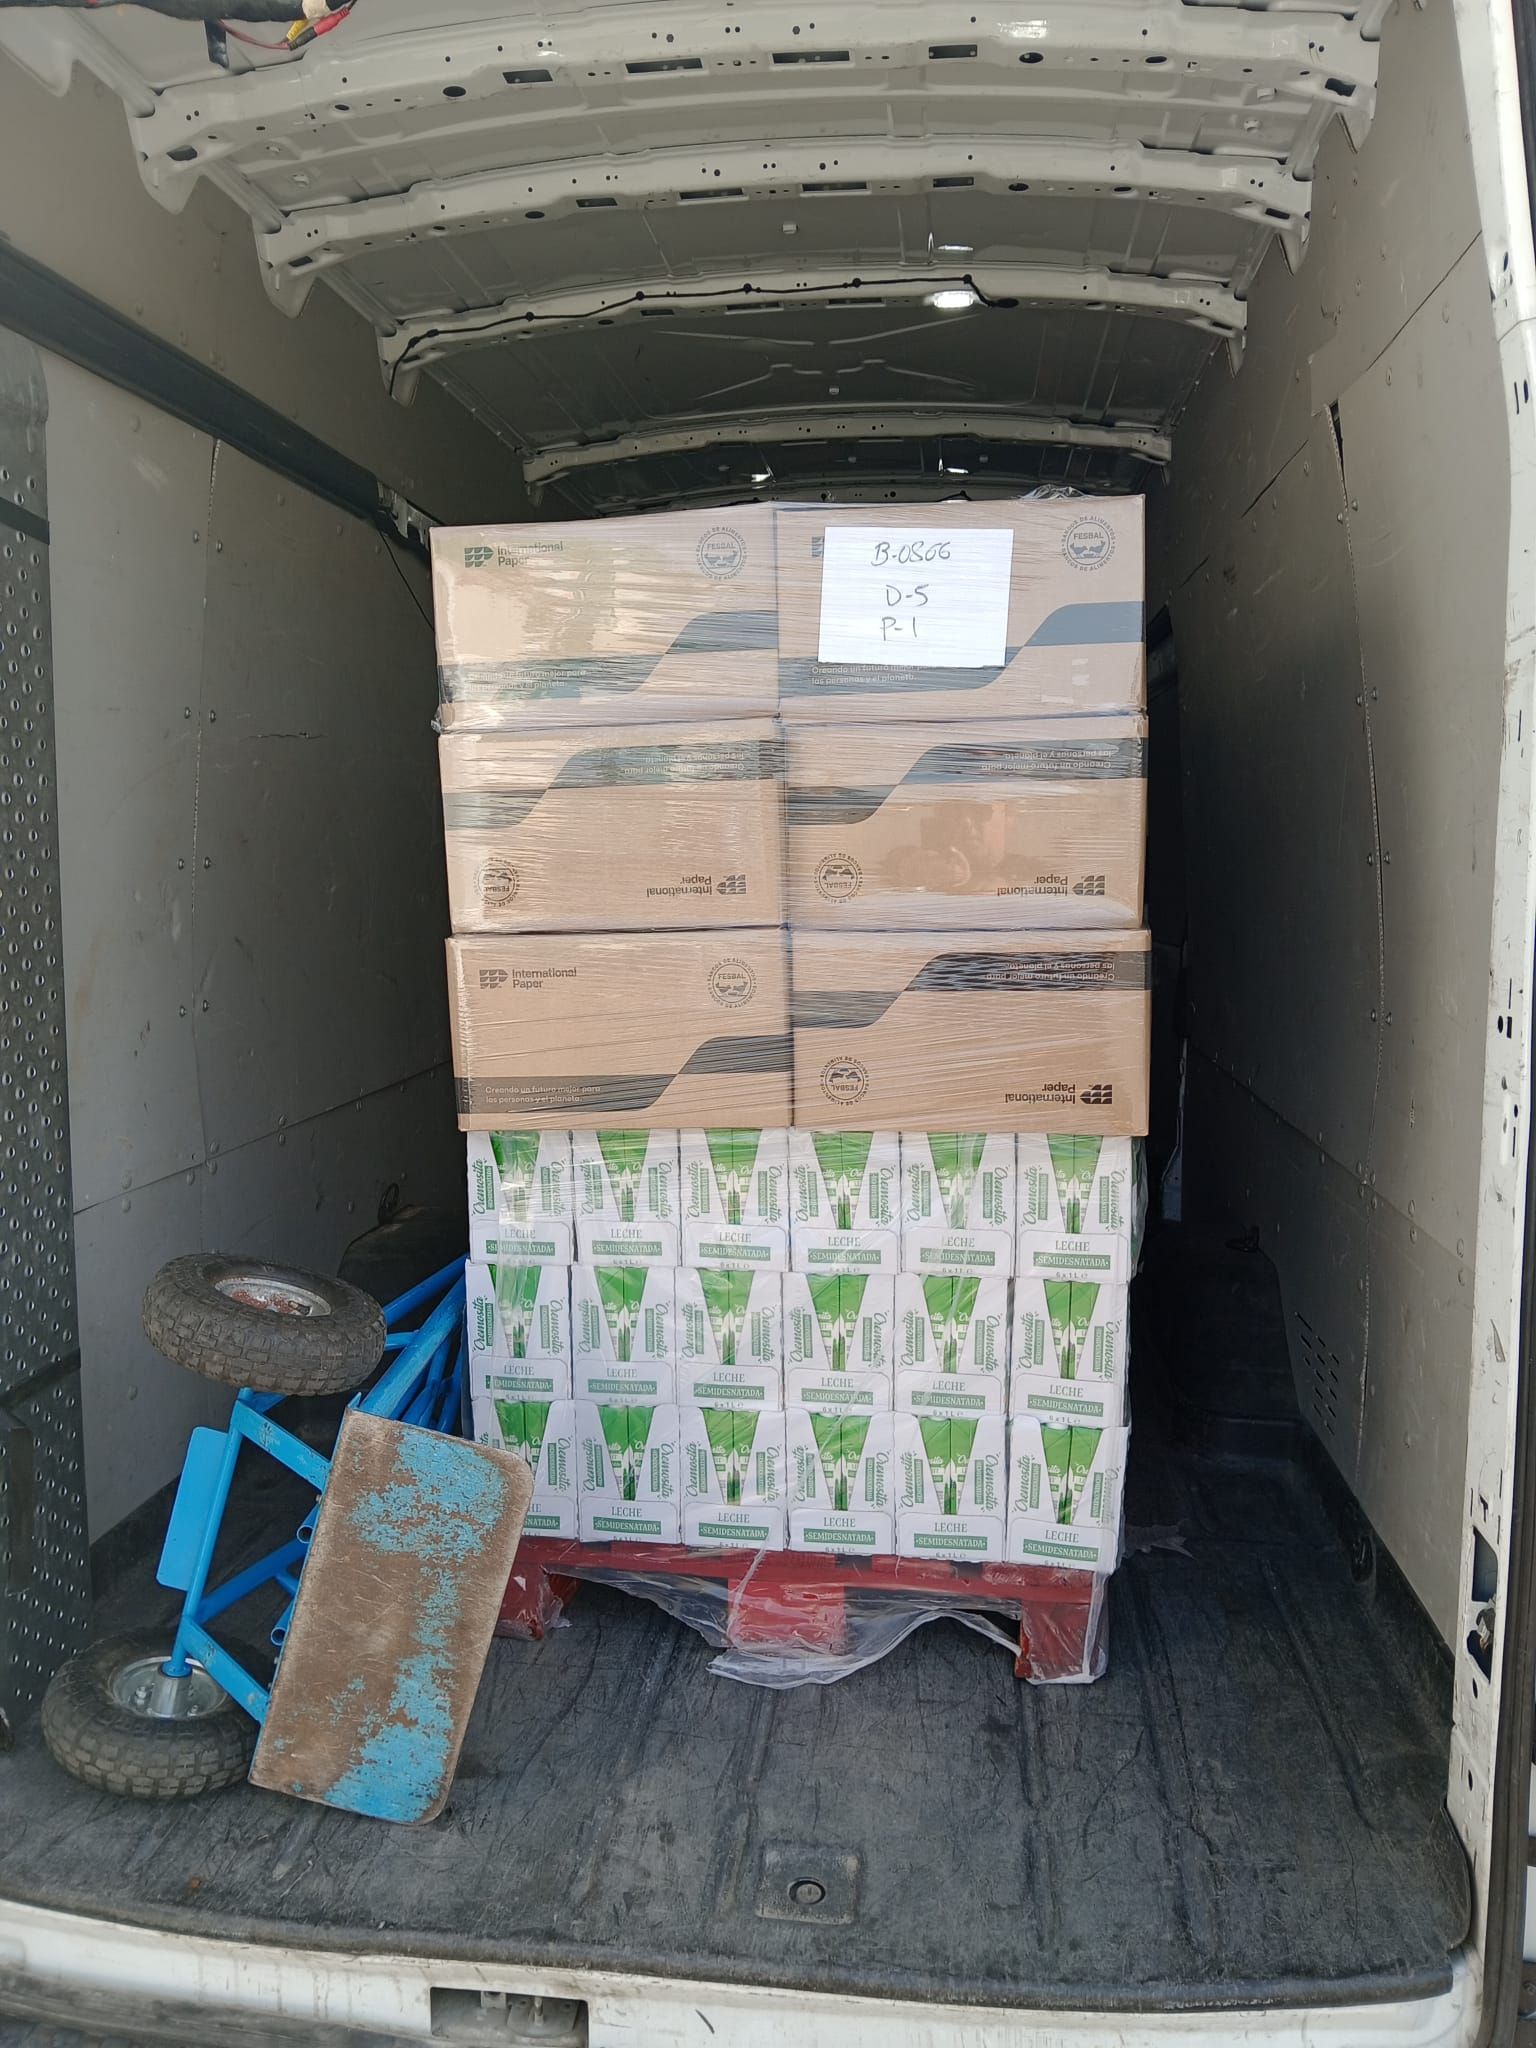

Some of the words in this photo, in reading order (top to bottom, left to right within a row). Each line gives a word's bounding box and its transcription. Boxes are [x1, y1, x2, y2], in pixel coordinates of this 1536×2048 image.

[1073, 532, 1104, 540] FESBAL
[497, 541, 563, 555] International
[498, 555, 529, 567] Paper
[885, 584, 930, 607] D-5
[680, 874, 712, 886] Paper
[824, 881, 852, 890] FESBAL
[1034, 875, 1068, 886] Paper
[646, 886, 712, 898] International
[997, 886, 1068, 897] International
[512, 967, 577, 978] International
[718, 972, 747, 981] FESBAL
[513, 978, 544, 989] Paper
[830, 1084, 859, 1093] FESBAL
[1041, 1082, 1076, 1094] Paper
[1005, 1093, 1076, 1105] International
[472, 1159, 485, 1215] Cremosita
[581, 1159, 593, 1214] Cremosita
[687, 1160, 701, 1218] Cremosita
[795, 1165, 809, 1222] Cremosita
[1024, 1167, 1038, 1225] Cremosita
[611, 1229, 642, 1239] LECHE
[719, 1232, 751, 1243] LECHE
[828, 1237, 861, 1247] LECHE
[1055, 1240, 1090, 1252] LECHE
[596, 1244, 659, 1255] SEMIDESNATADA
[703, 1245, 767, 1259] SEMIDESNATADA
[812, 1250, 878, 1264] SEMIDESNATADA
[1038, 1254, 1107, 1269] SEMIDESNATADA
[473, 1297, 485, 1352] Cremosita
[681, 1303, 694, 1359] Cremosita
[790, 1308, 804, 1363] Cremosita
[900, 1311, 915, 1367] Cremosita
[1019, 1313, 1034, 1369] Cremosita
[504, 1366, 534, 1376] LECHE
[607, 1368, 637, 1378] LECHE
[714, 1372, 745, 1383] LECHE
[821, 1378, 854, 1388] LECHE
[933, 1381, 965, 1392] LECHE
[697, 1385, 761, 1399] SEMIDESNATADA
[806, 1389, 871, 1403] SEMIDESNATADA
[1049, 1386, 1083, 1398] LECHE
[916, 1393, 983, 1407] SEMIDESNATADA
[1032, 1398, 1100, 1414] SEMIDESNATADA
[583, 1438, 596, 1491] Cremosita
[687, 1442, 699, 1498] Cremosita
[795, 1446, 808, 1503] Cremosita
[900, 1452, 915, 1508] Cremosita
[1014, 1455, 1030, 1512] Cremosita
[611, 1506, 642, 1517] LECHE
[718, 1512, 750, 1523] LECHE
[525, 1517, 559, 1529] SNATADA
[597, 1519, 659, 1533] SEMIDESNATADA
[824, 1517, 856, 1528] LECHE
[935, 1522, 968, 1533] LECHE
[702, 1526, 767, 1539] SEMIDESNATADA
[808, 1531, 873, 1544] SEMIDESNATADA
[1045, 1530, 1079, 1543] LECHE
[919, 1535, 985, 1549] SEMIDESNATADA
[1027, 1543, 1097, 1560] SEMIDESNATADA
